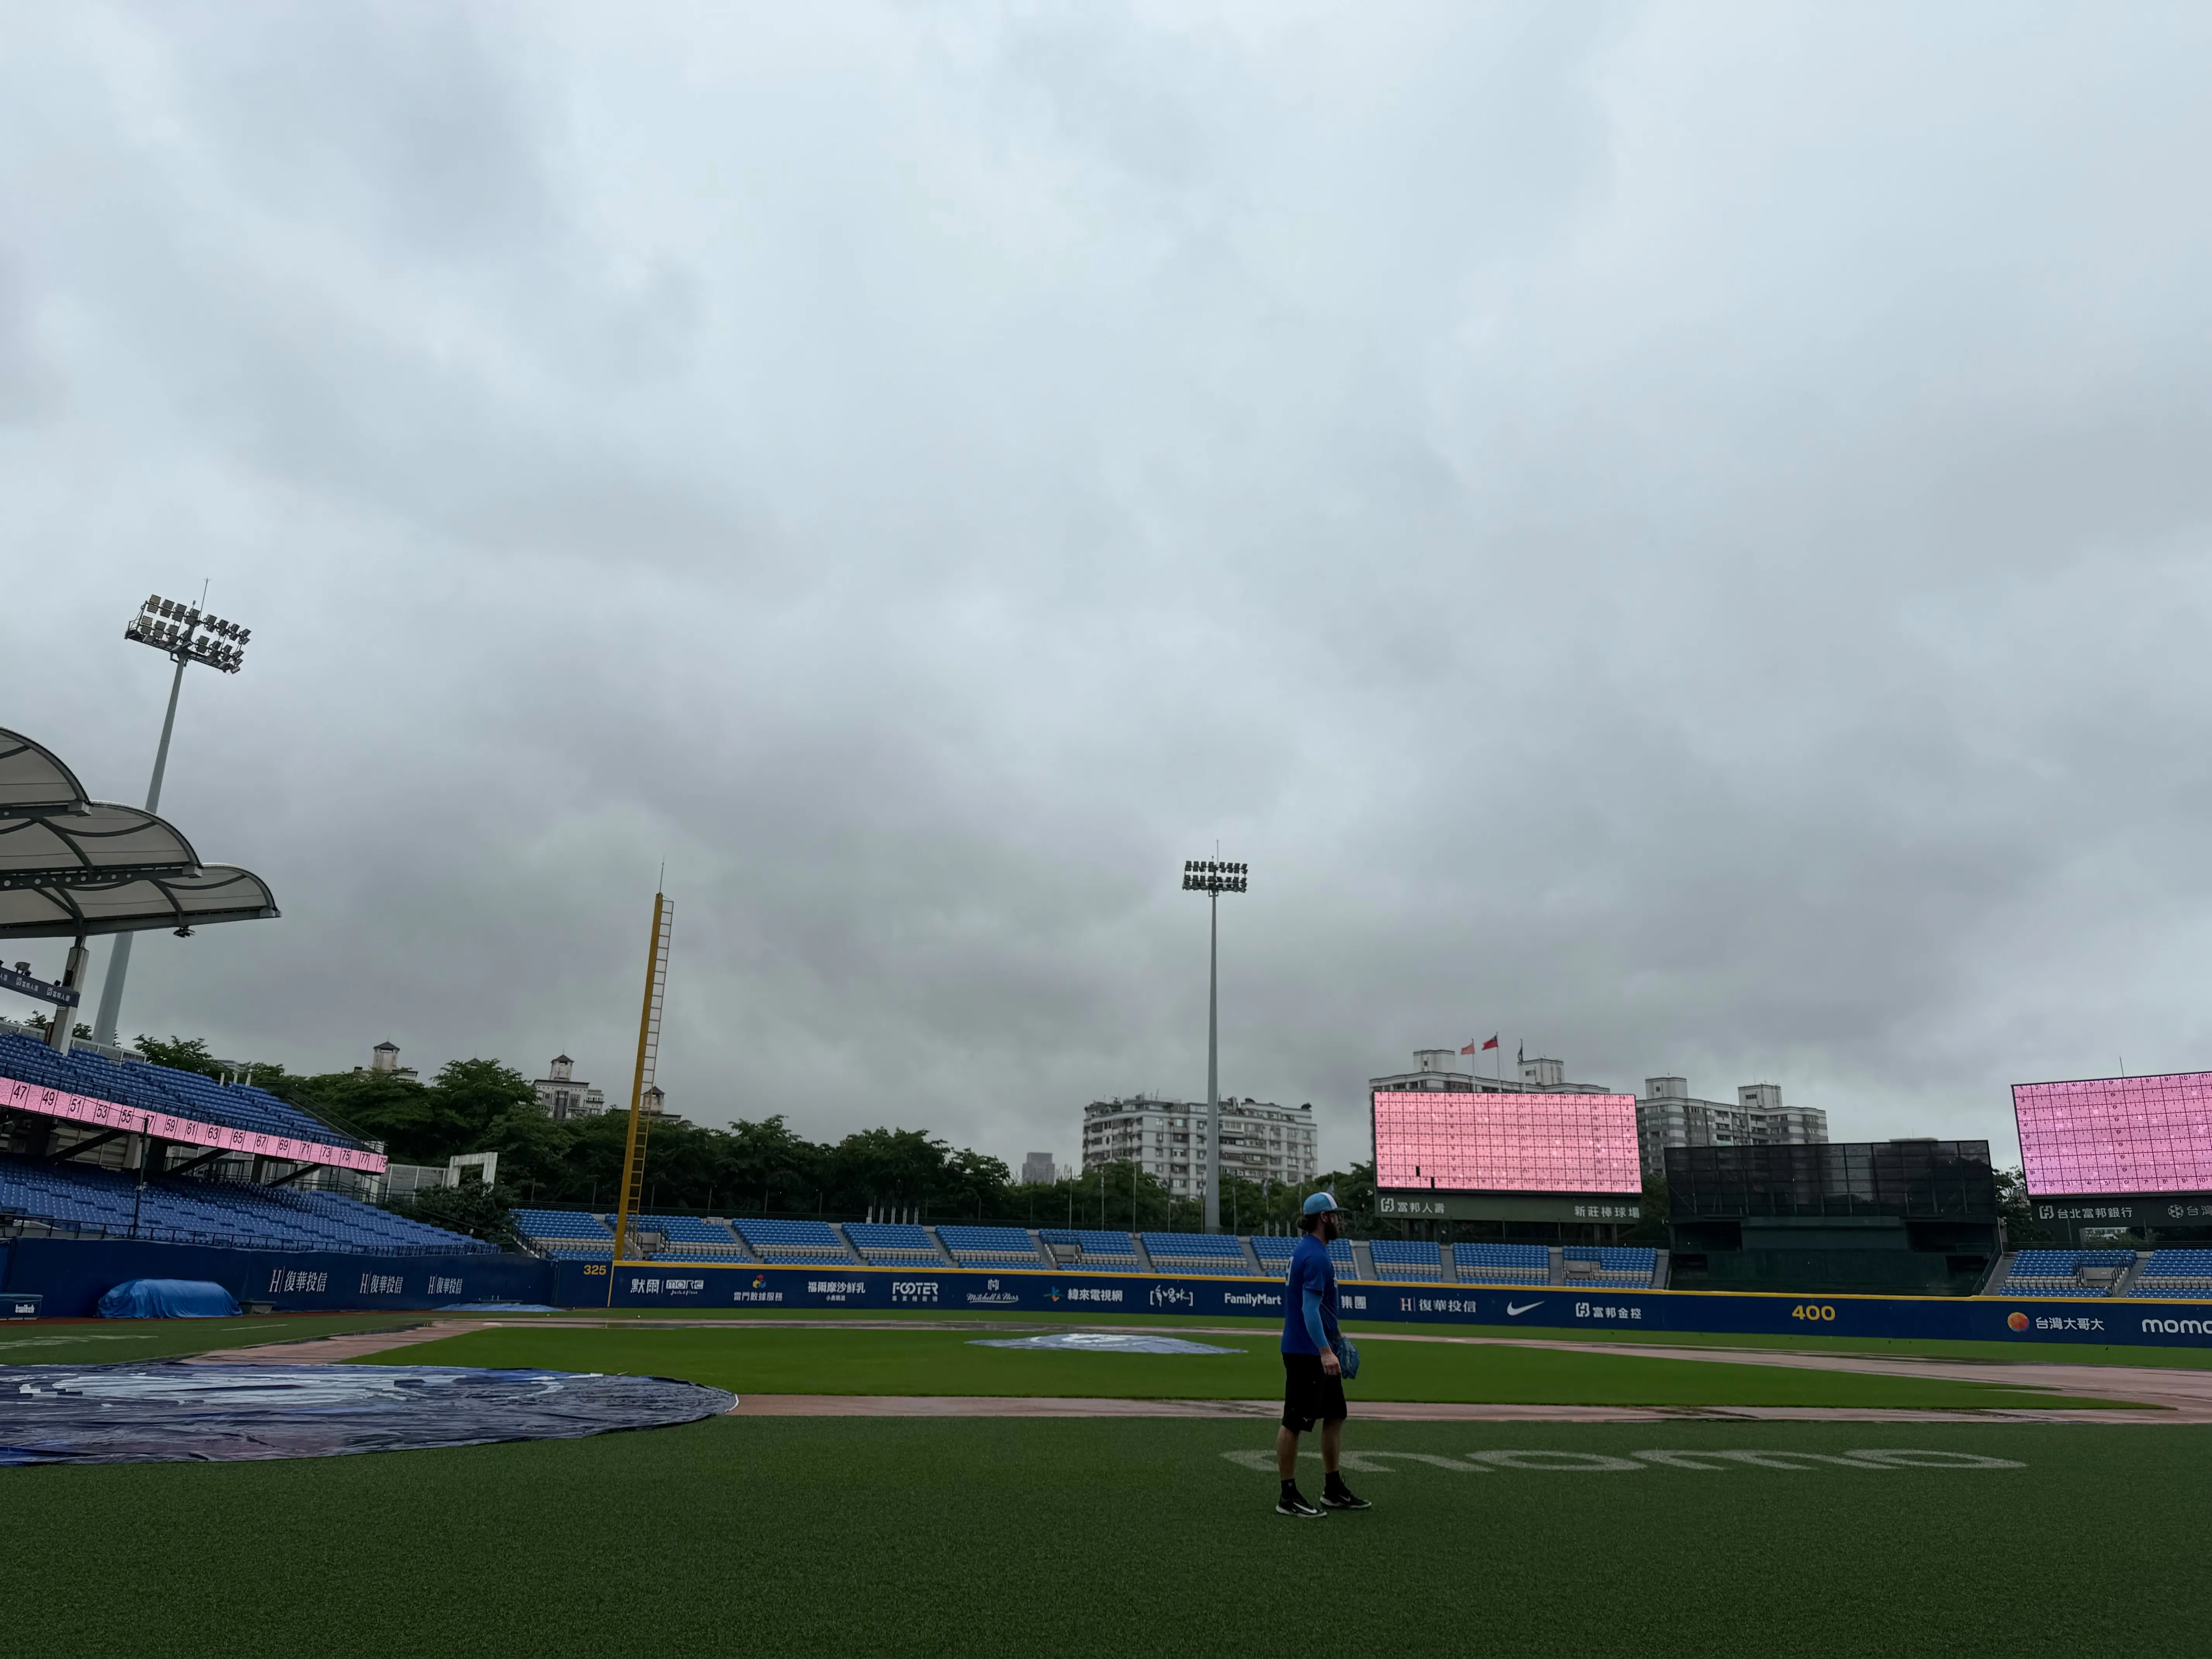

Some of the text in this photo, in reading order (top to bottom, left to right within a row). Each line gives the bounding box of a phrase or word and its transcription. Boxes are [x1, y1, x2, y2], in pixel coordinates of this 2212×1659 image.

[14, 1084, 27, 1100] 47
[42, 1091, 55, 1106] 49
[70, 1098, 82, 1113] 51
[96, 1104, 108, 1118] 53
[121, 1109, 132, 1123] 55
[166, 1119, 175, 1132] 59
[187, 1123, 196, 1136] 61
[208, 1127, 218, 1140] 63
[233, 1132, 244, 1144] 65
[256, 1136, 267, 1147] 67
[279, 1139, 289, 1151] 69
[301, 1143, 310, 1154] 71
[323, 1146, 331, 1158] 73
[342, 1150, 350, 1161] 75
[361, 1153, 369, 1163] 77
[379, 1157, 387, 1167] 79
[1397, 1201, 1445, 1214] 富邦人壽
[1574, 1205, 1640, 1218] 新莊棒球場
[2057, 1207, 2132, 1219] 台北富邦銀行
[2187, 1205, 2212, 1216] 台灣
[584, 1265, 606, 1275] 325
[284, 1271, 327, 1292] 復華投信
[370, 1274, 403, 1294] 復華投信
[436, 1276, 462, 1294] 復華投信
[630, 1279, 659, 1294] 默爾
[807, 1281, 866, 1294] 福爾摩沙鮮乳
[892, 1282, 939, 1295] FOOTER
[966, 1292, 996, 1301] Mitchell
[1067, 1288, 1123, 1302] 緯來電視網
[1224, 1293, 1281, 1307] FamilyMart
[15, 1304, 35, 1314] twitch
[1419, 1298, 1476, 1313] 復華投信
[1593, 1307, 1642, 1319] 富邦金控
[1792, 1305, 1836, 1321] 400
[2035, 1317, 2105, 1331] 台灣大哥大
[2142, 1319, 2212, 1334] momo
